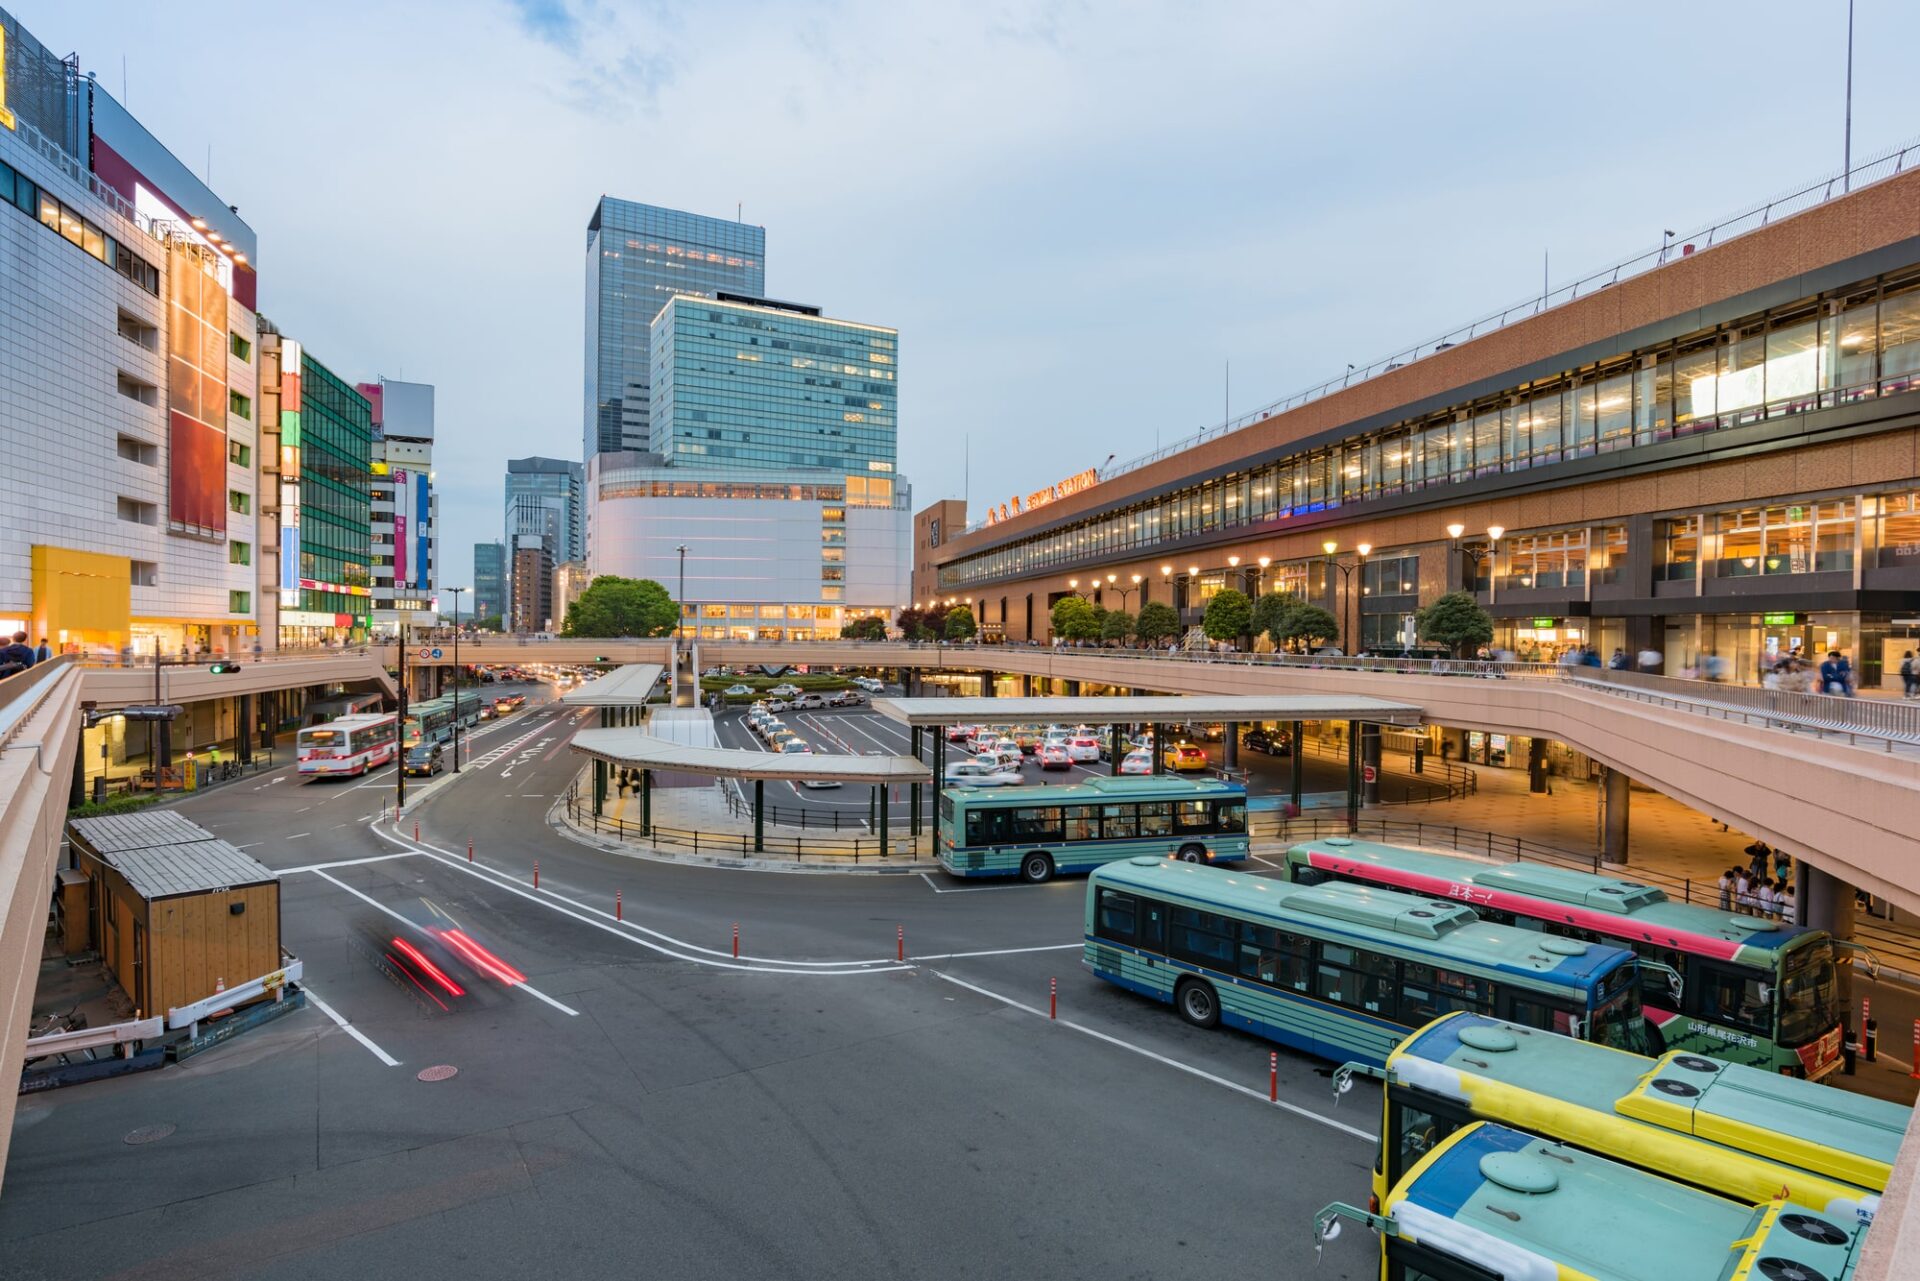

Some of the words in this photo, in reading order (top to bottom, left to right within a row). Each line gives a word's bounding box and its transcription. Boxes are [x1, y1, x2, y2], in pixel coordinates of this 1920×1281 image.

[1057, 467, 1096, 497] STATION
[1688, 1022, 1758, 1048] 山形県尾花沢市
